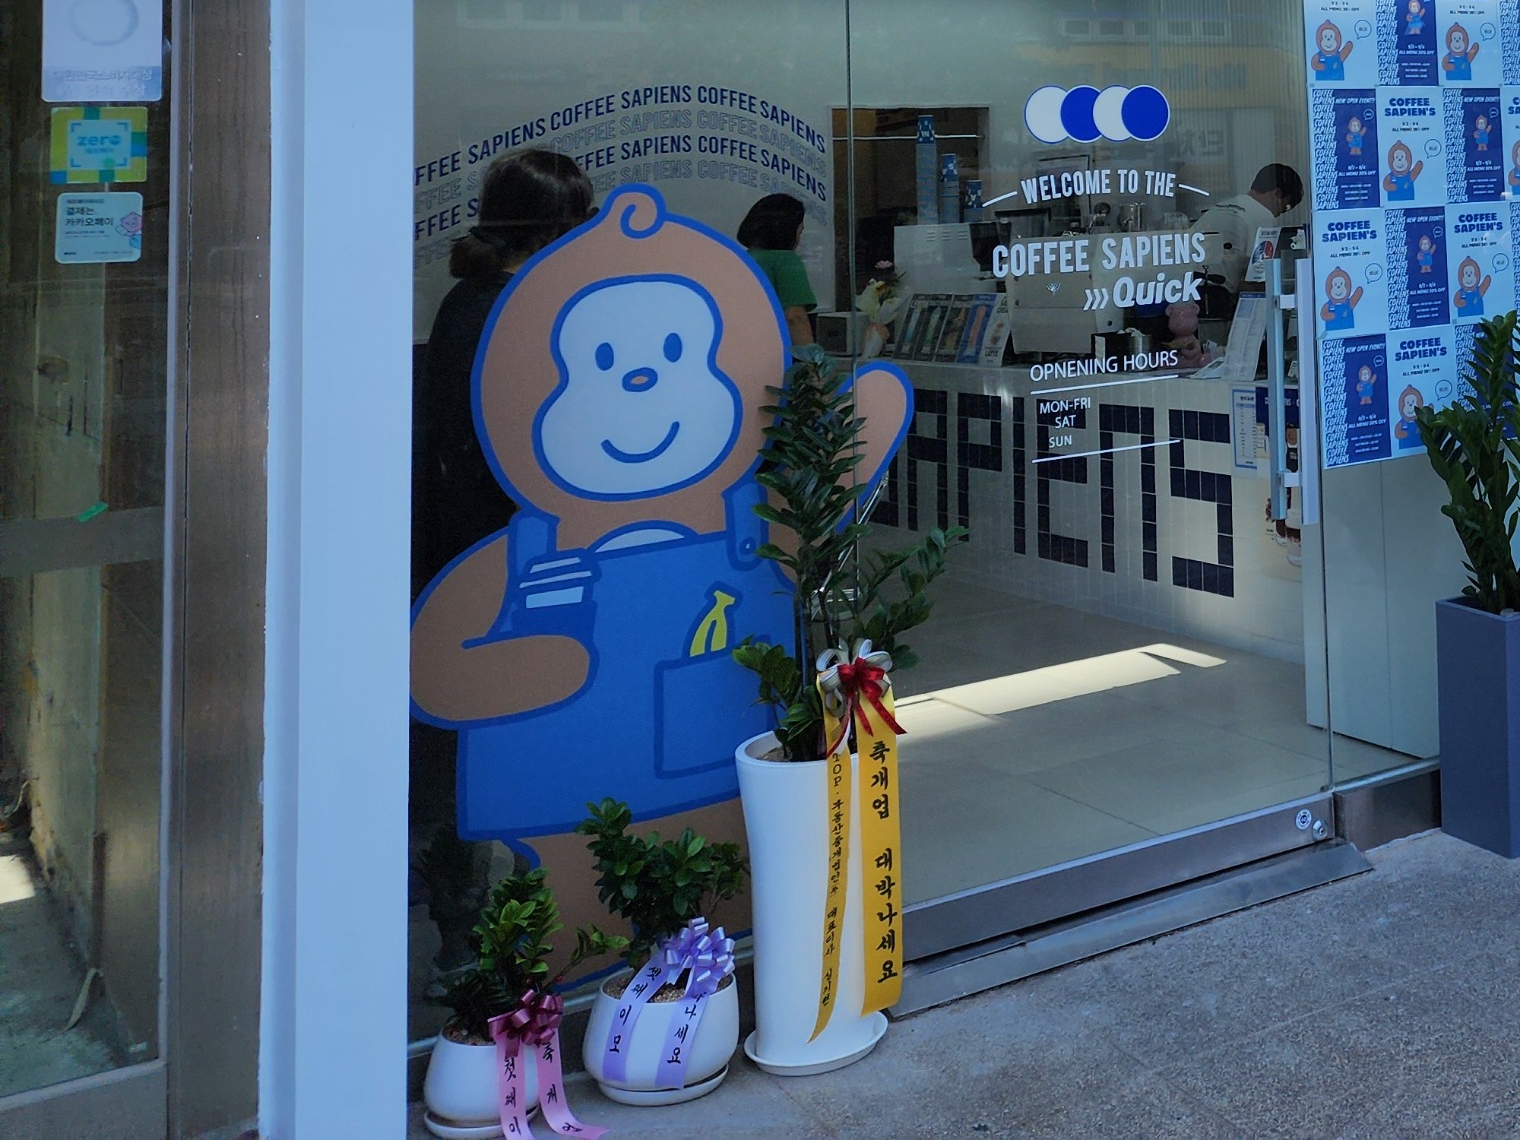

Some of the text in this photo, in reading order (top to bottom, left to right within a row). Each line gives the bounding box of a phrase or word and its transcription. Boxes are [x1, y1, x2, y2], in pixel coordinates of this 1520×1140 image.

[1389, 97, 1431, 108] COFFEE
[1384, 106, 1436, 118] SAPIEN'S
[468, 117, 547, 166] SAPIENS
[550, 94, 616, 132] COFFEE
[621, 84, 692, 111] SAPIENS
[697, 86, 758, 116] COFFEE
[760, 100, 827, 155] SAPIENS
[621, 134, 692, 161] SAPIENS
[698, 135, 759, 163] COFFEE
[761, 149, 828, 202] SAPIENS
[1021, 169, 1177, 206] WELCOME TO THE
[65, 217, 115, 229] 카카오페이
[1457, 212, 1498, 224] COFFEE
[1327, 220, 1372, 232] COFFEE
[1453, 221, 1504, 234] SAPIEN'S
[1322, 230, 1377, 243] SAPIEN'S
[992, 231, 1207, 280] COFFEE SAPIENS
[1112, 271, 1203, 310] Quick
[1399, 337, 1442, 350] COFFEE
[1394, 347, 1448, 362] SAPIEN'S
[1030, 349, 1179, 383] OPNENING HOURS
[1039, 396, 1092, 416] MON-FRI
[1054, 414, 1076, 429] SAT
[1048, 434, 1073, 449] SUN
[868, 739, 899, 986] 축개업 대박나세요
